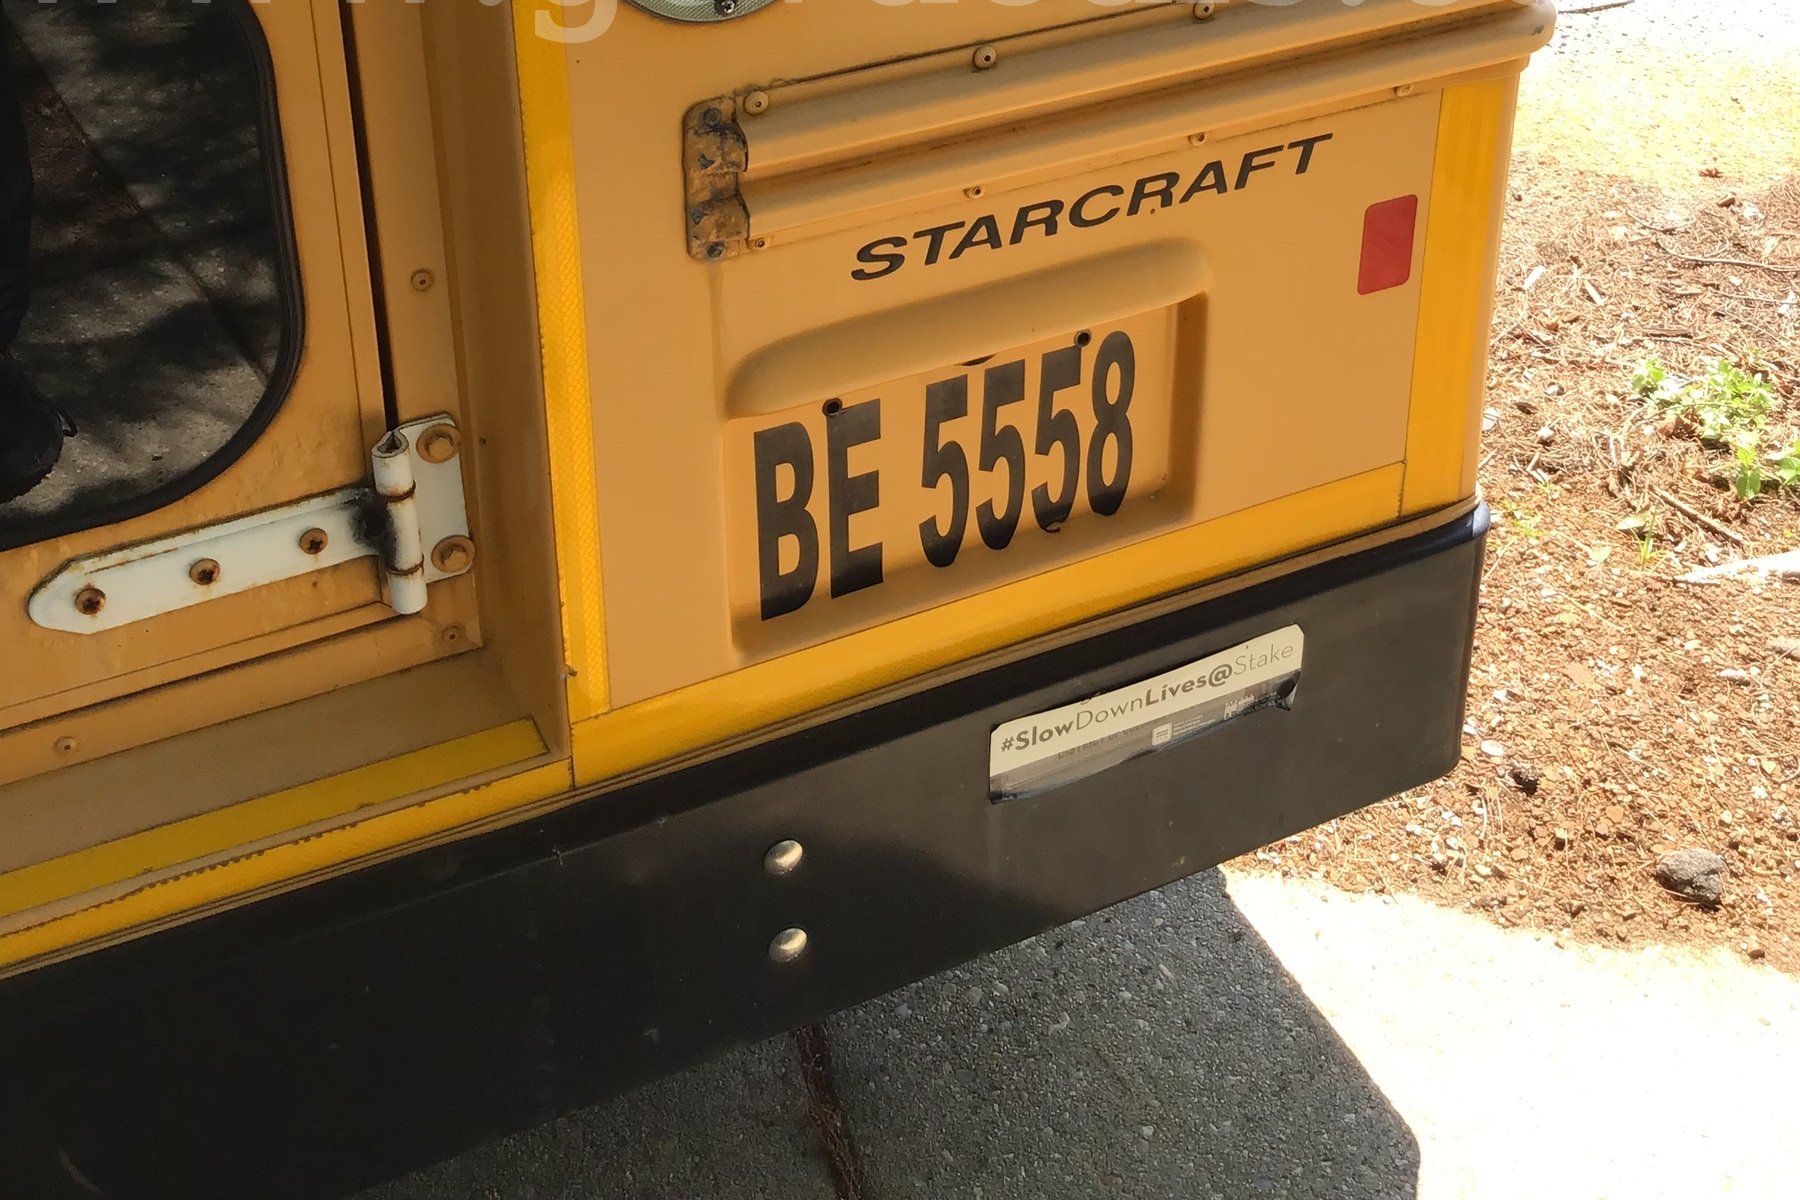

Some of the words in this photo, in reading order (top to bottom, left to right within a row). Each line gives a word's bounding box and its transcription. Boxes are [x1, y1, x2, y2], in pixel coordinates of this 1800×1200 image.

[850, 133, 1333, 281] STARCRAFT
[753, 398, 884, 621] BE
[918, 331, 1136, 568] 5558
